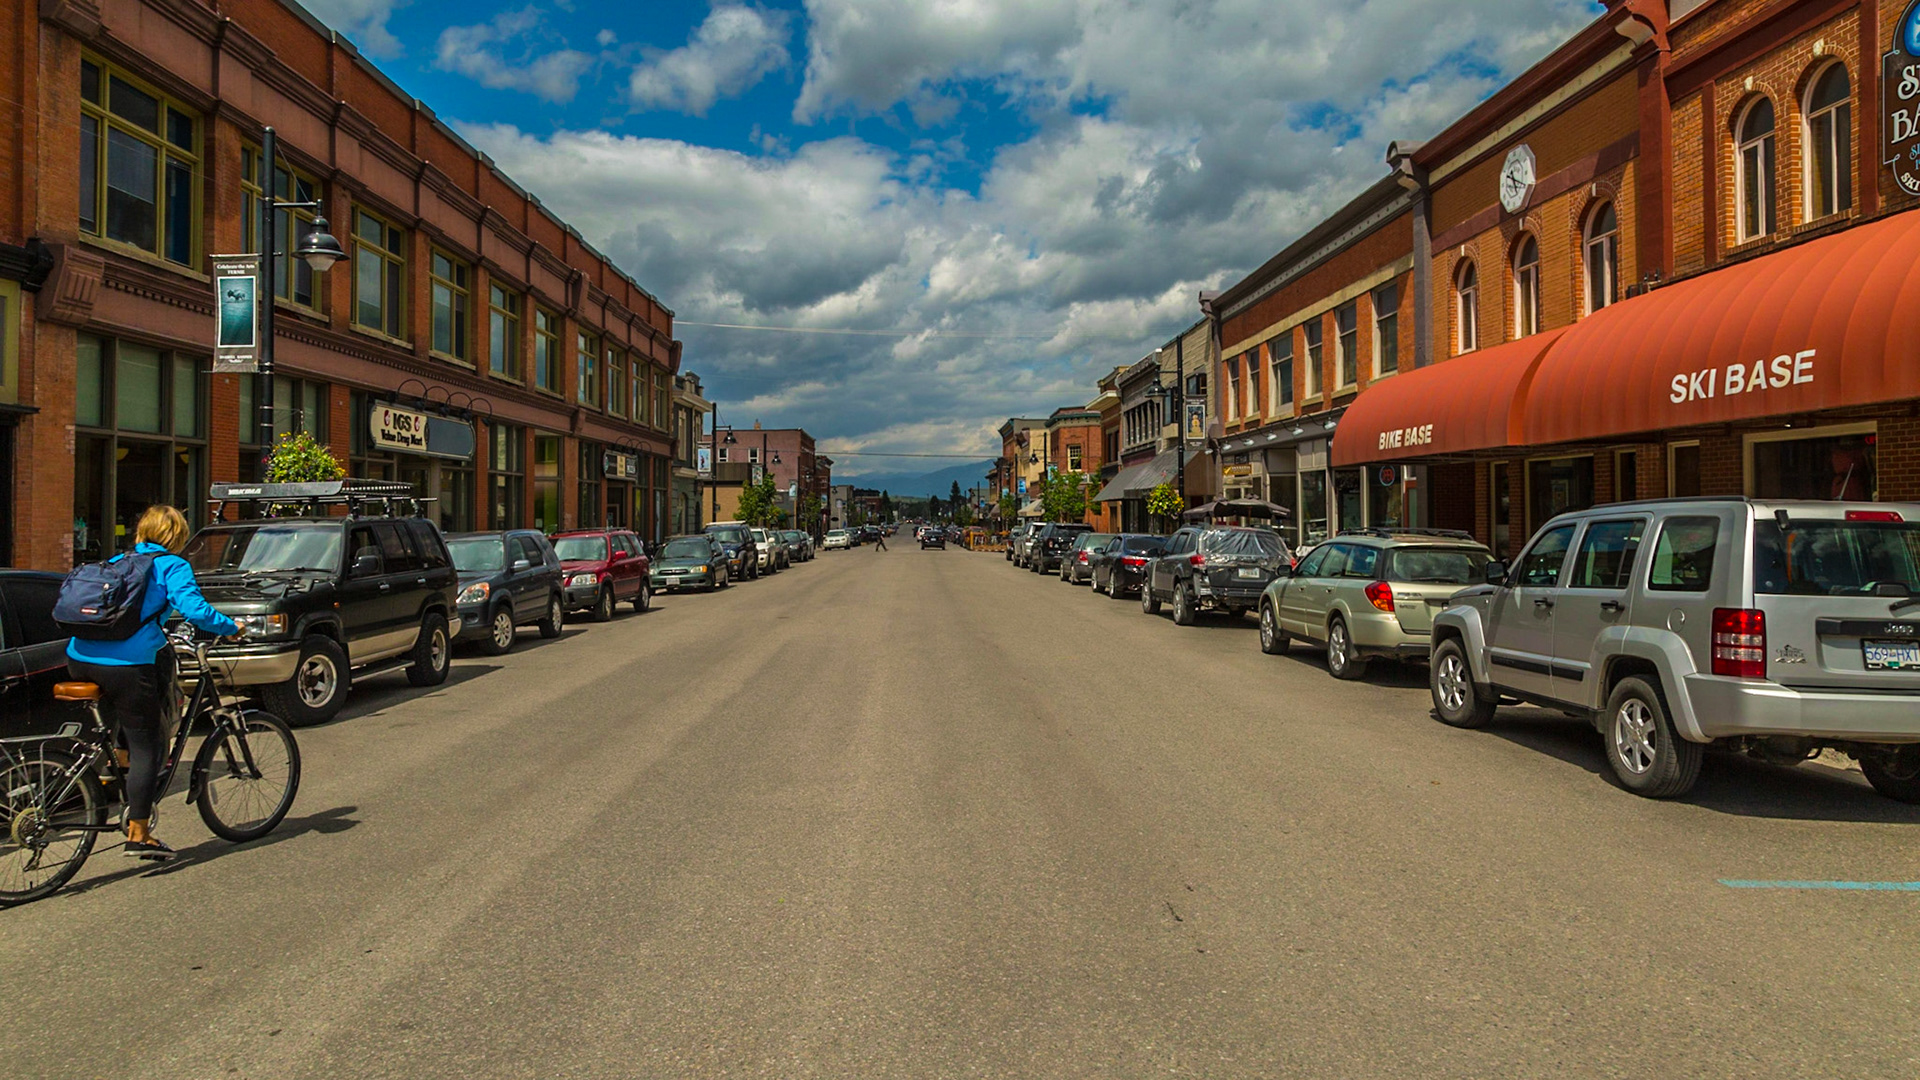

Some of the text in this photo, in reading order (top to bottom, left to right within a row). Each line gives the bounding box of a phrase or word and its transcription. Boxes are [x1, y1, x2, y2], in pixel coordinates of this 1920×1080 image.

[1897, 64, 1920, 100] S
[1670, 349, 1816, 404] SKI BASE
[381, 429, 423, 446] Value Drug Mart
[1379, 424, 1433, 450] BIKE BASE
[228, 488, 262, 496] YAKIMA
[1884, 623, 1913, 635] Jeep
